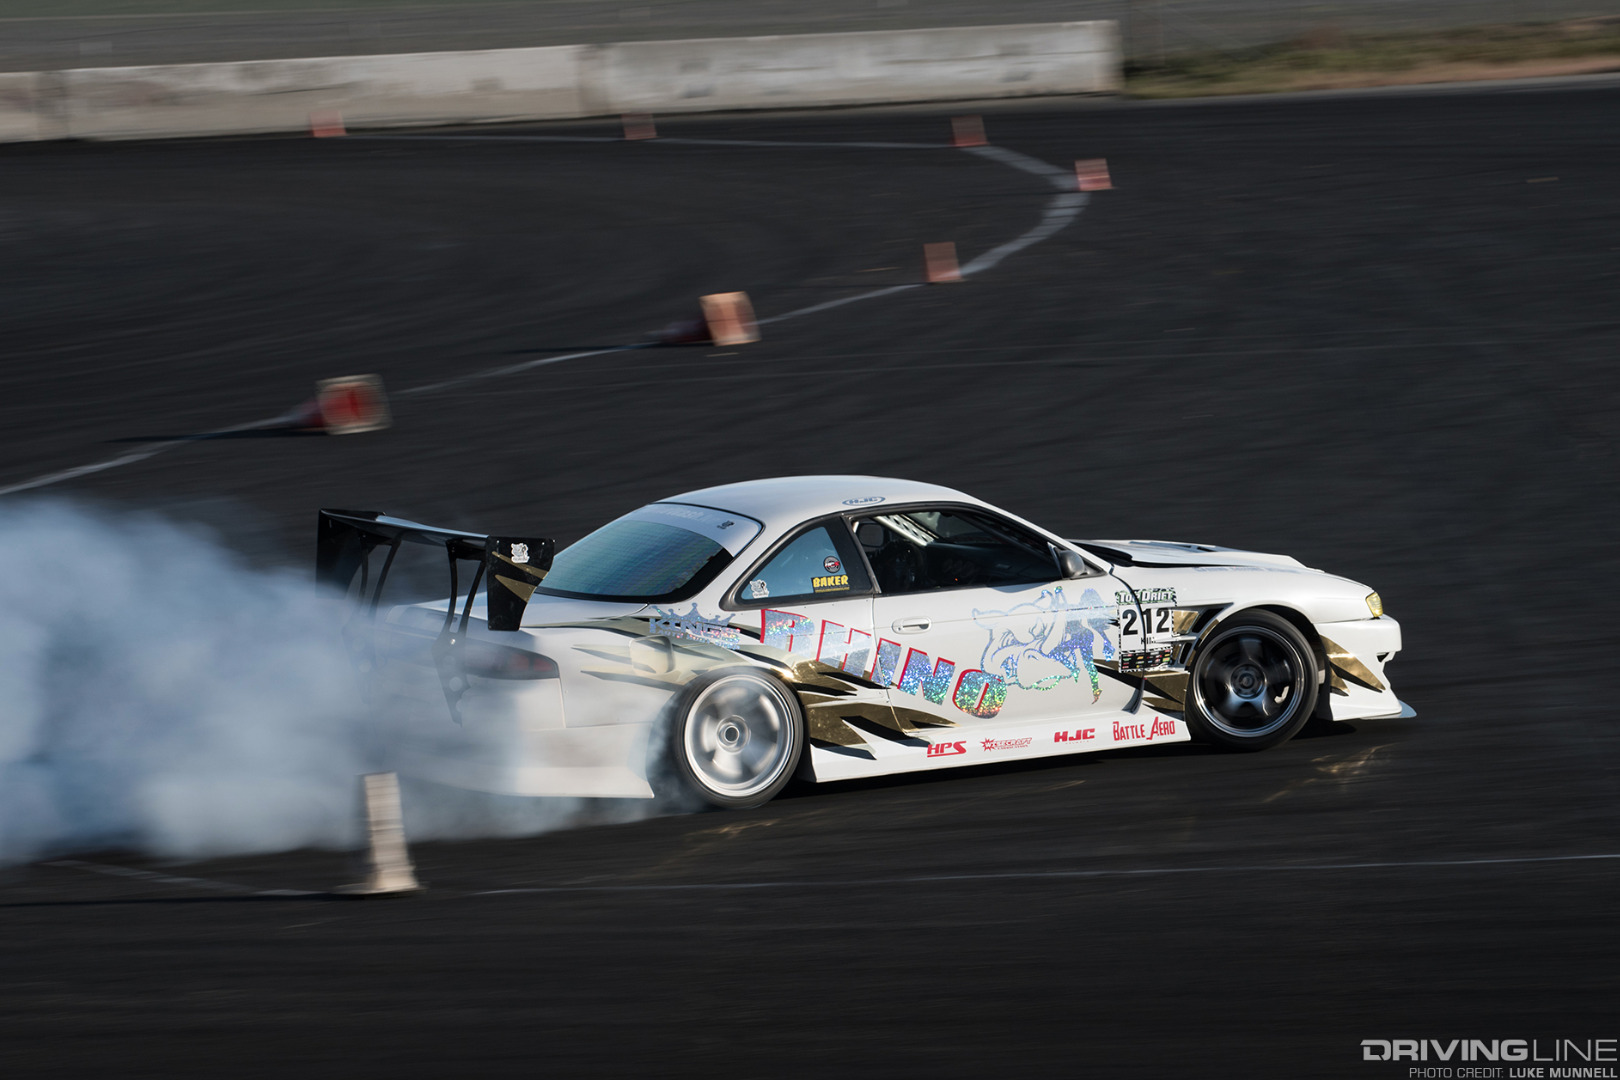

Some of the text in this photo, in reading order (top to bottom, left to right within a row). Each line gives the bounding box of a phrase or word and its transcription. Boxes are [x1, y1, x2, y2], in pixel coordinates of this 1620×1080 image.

[812, 575, 848, 588] BAKER
[1141, 590, 1173, 602] DRIFT
[649, 617, 741, 643] KINGS
[1122, 608, 1170, 636] 212
[759, 608, 1007, 719] RHINO
[1054, 728, 1096, 742] HJC
[1112, 716, 1176, 741] BATTLE AERO
[926, 740, 967, 757] HPS
